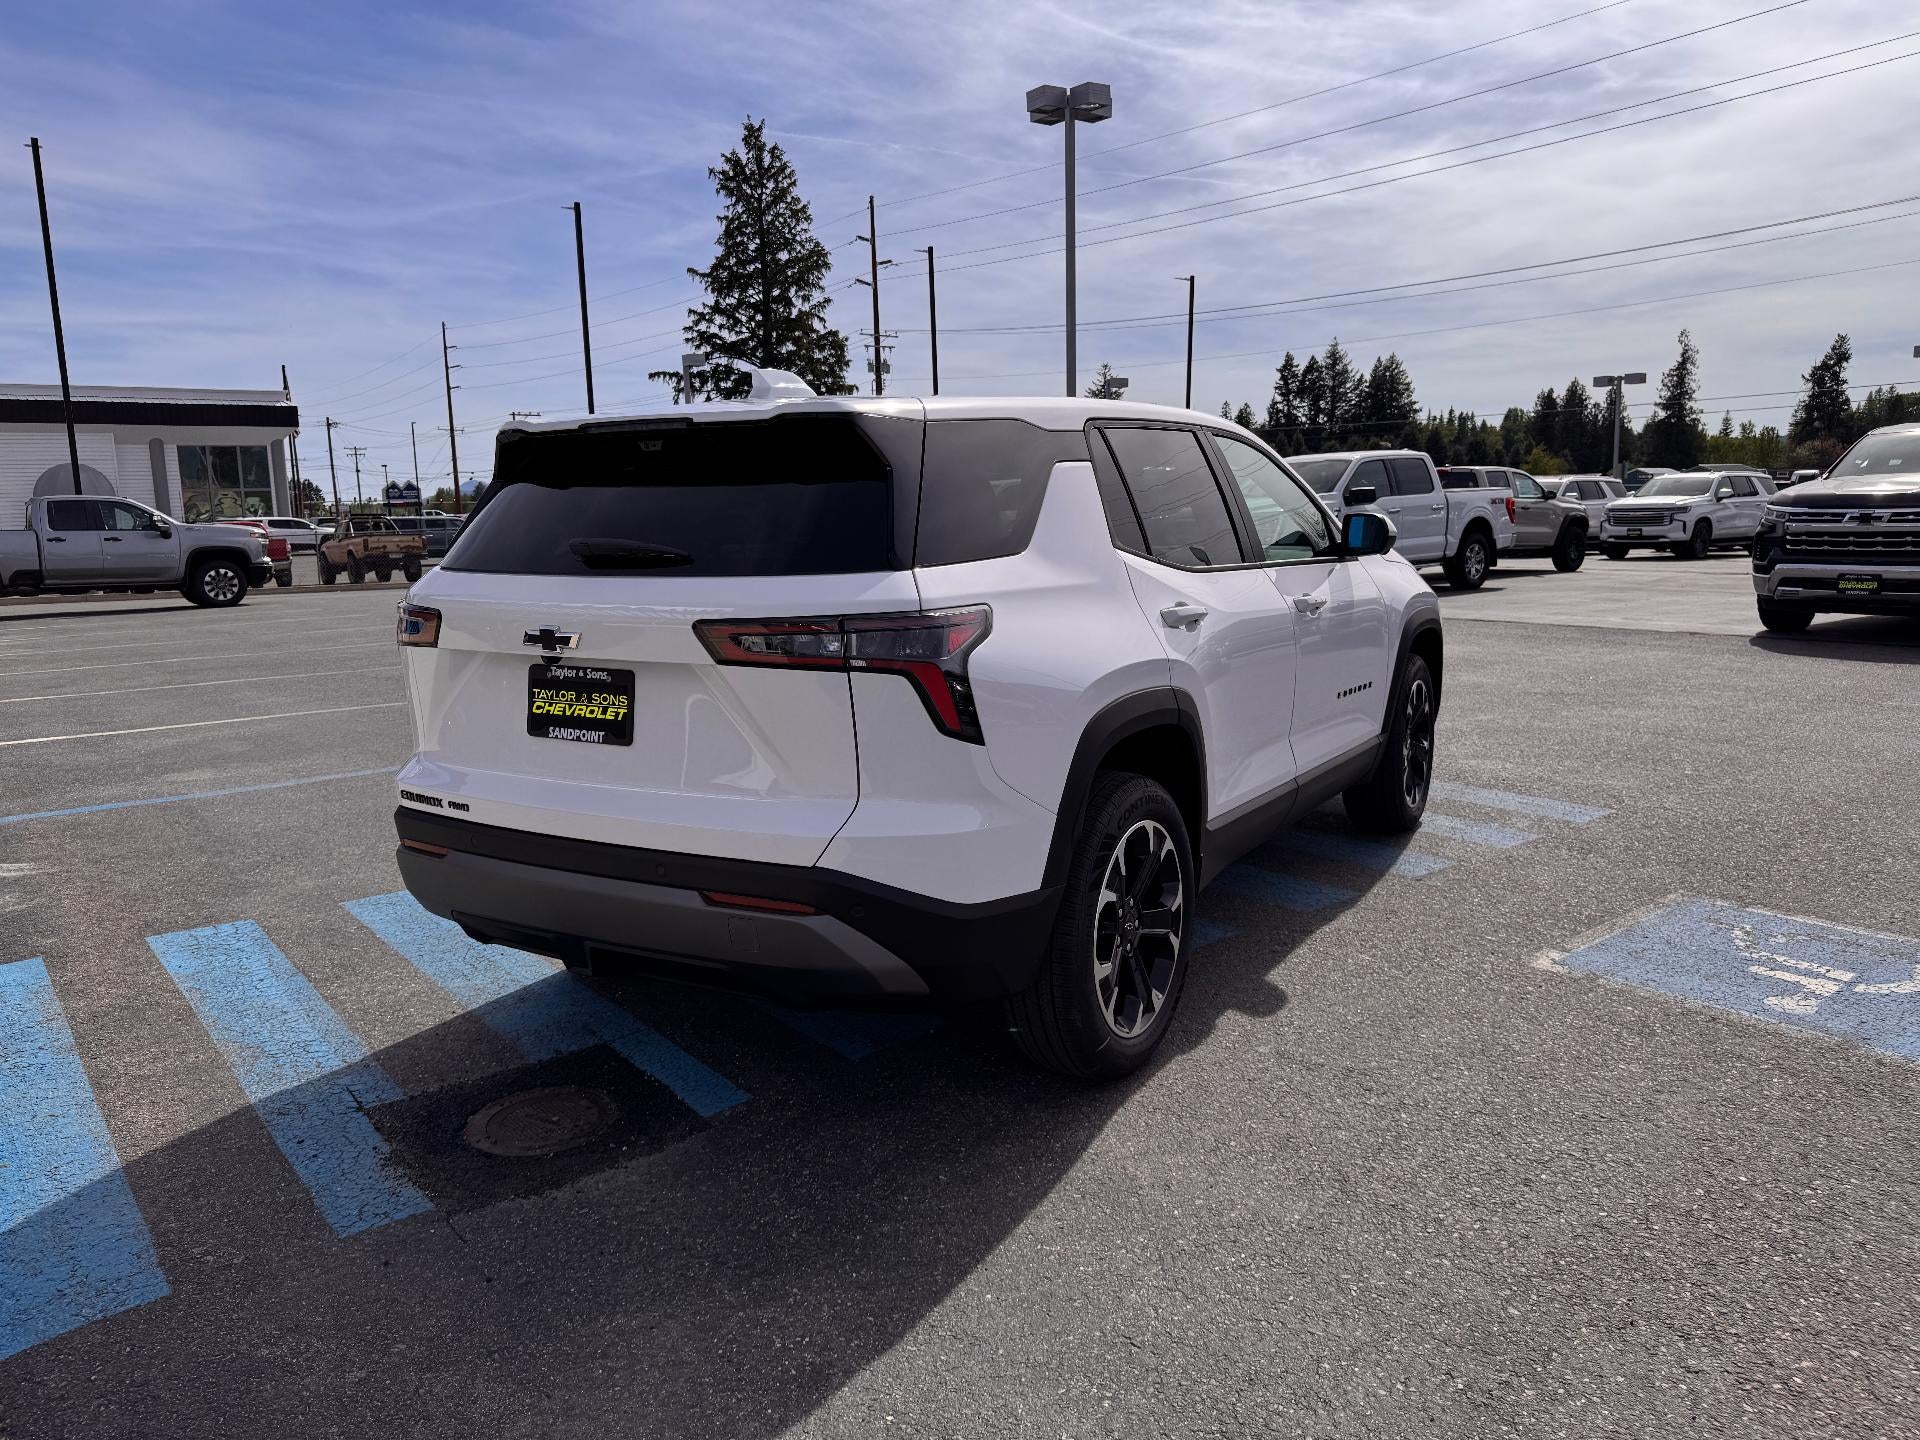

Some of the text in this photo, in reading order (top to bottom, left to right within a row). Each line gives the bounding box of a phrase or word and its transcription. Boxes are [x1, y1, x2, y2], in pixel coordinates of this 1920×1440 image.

[550, 666, 608, 680] Taylor & Sons
[532, 688, 628, 706] TAYLOR & SONS
[532, 701, 628, 721] CHEVROLET
[548, 726, 605, 743] SANDPOINT
[400, 789, 444, 809] EQUINOX
